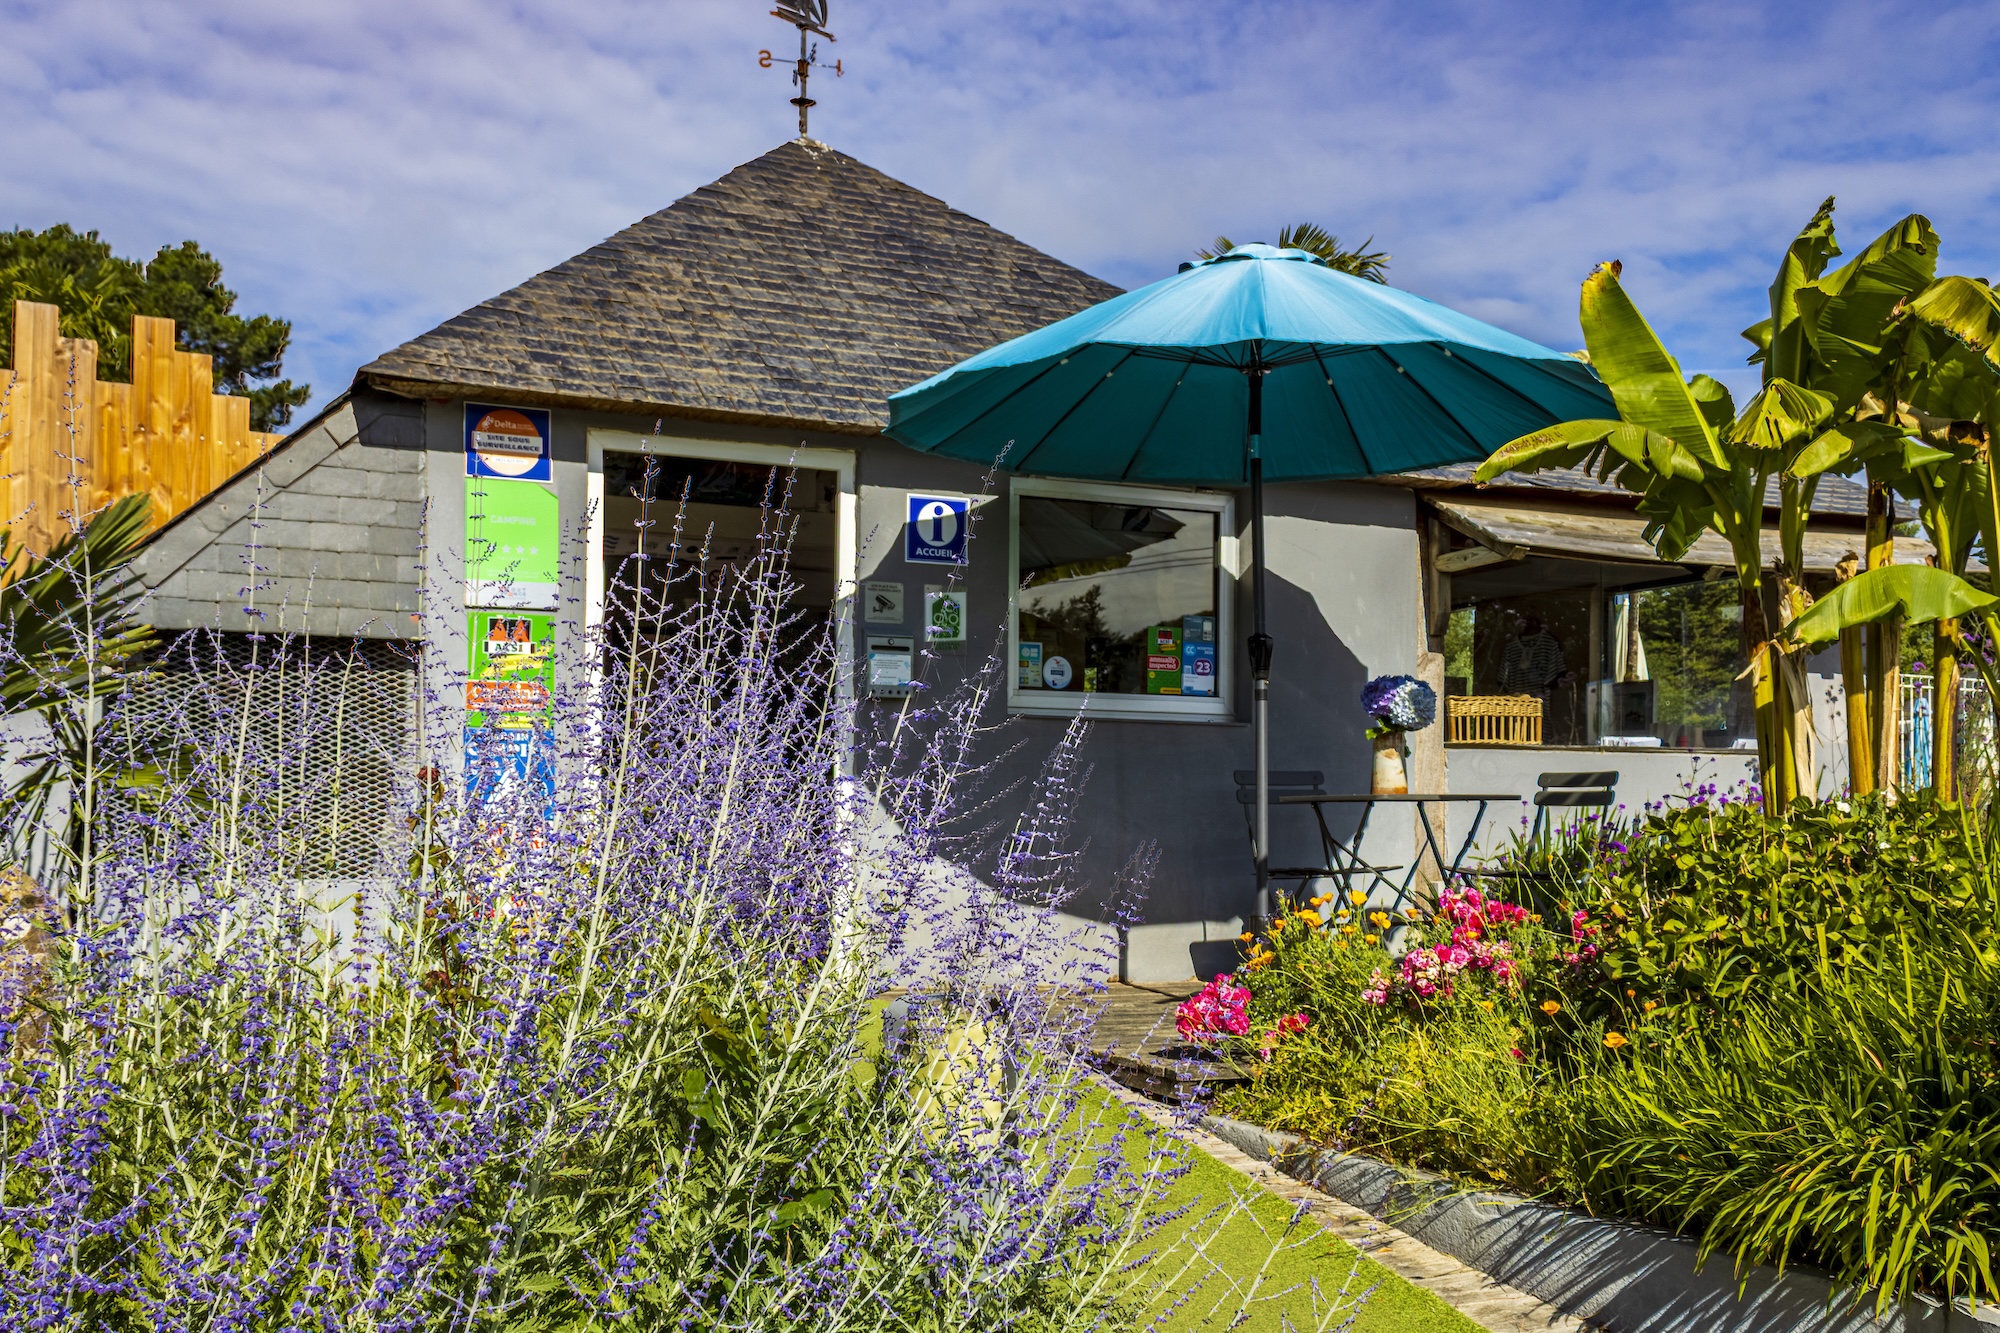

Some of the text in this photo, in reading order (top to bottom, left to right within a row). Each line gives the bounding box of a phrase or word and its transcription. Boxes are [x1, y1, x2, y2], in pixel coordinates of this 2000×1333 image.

[494, 420, 517, 429] Delta
[507, 436, 530, 444] SOUS
[477, 441, 540, 452] SURVEILLANCE
[490, 514, 537, 526] CAMPING
[915, 547, 954, 558] ACCUEIL
[1149, 656, 1176, 664] annually
[1149, 662, 1176, 670] inspected
[1196, 661, 1211, 673] 23
